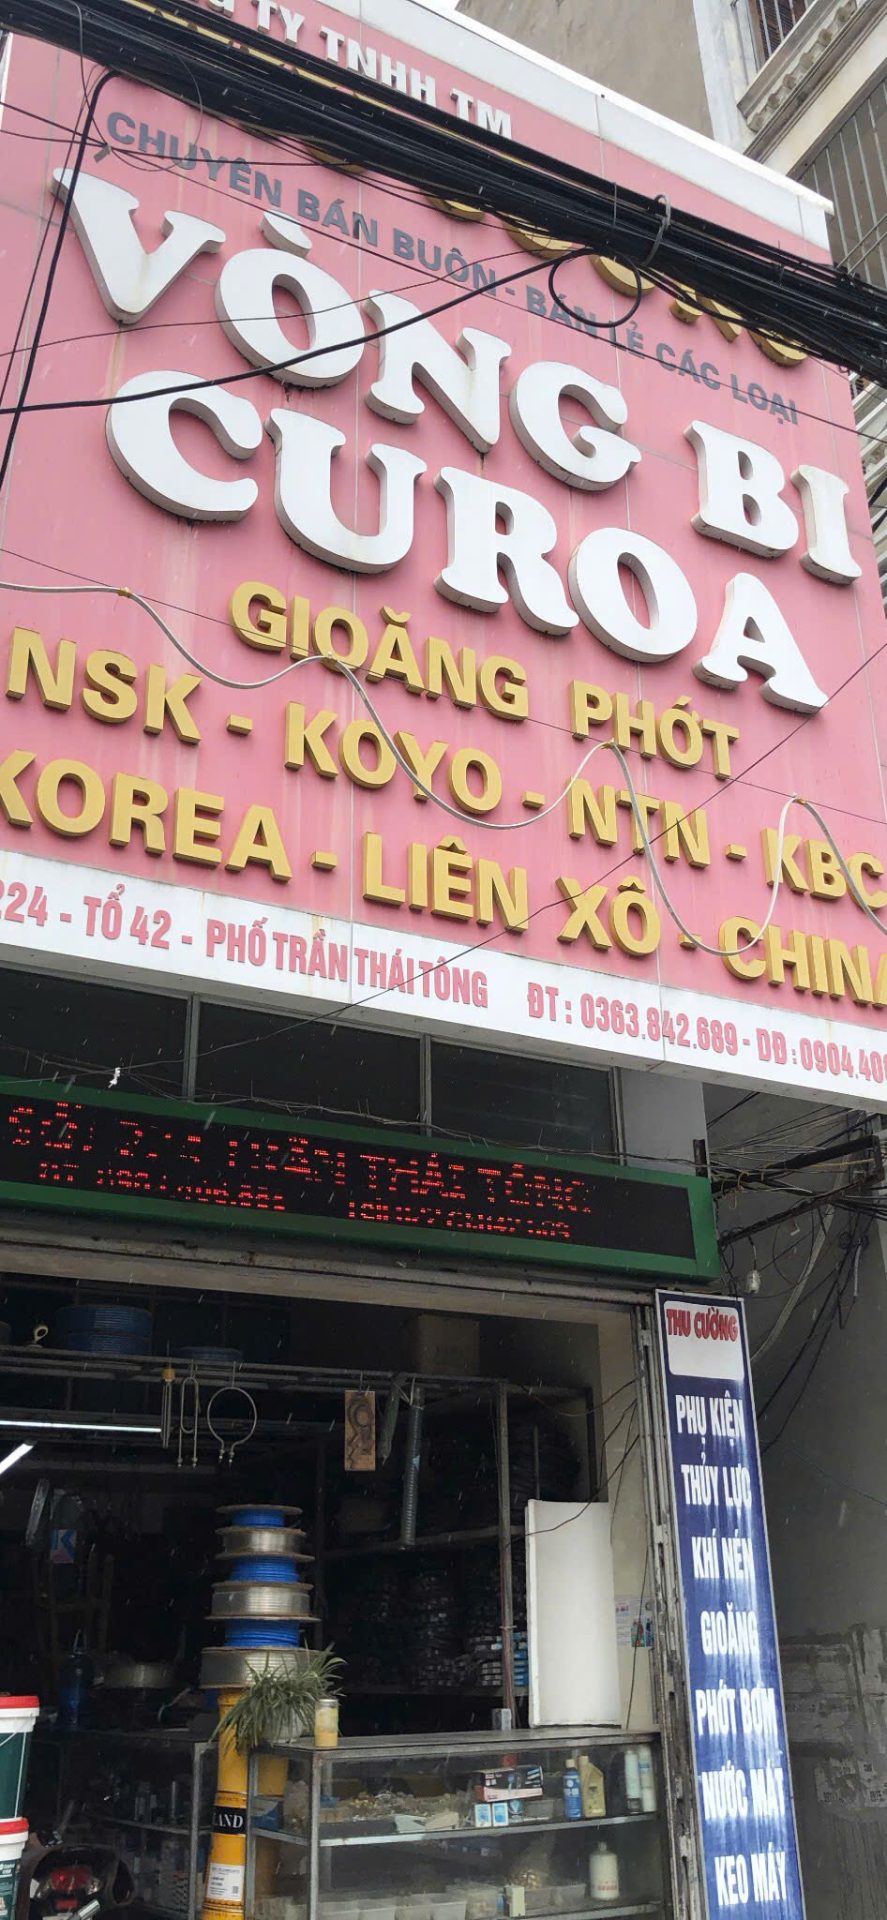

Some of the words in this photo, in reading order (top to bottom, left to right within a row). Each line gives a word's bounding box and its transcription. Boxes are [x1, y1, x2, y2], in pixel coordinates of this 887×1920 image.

[256, 0, 305, 46] TY
[320, 25, 437, 108] TNHH
[450, 88, 513, 140] TM
[97, 111, 283, 208] CHUYÊN
[297, 187, 379, 247] BÁN
[392, 227, 497, 296] BUÔN
[655, 342, 721, 391] CÁC
[731, 373, 800, 426] LOẠI
[53, 167, 642, 492] VÒNG
[683, 420, 862, 586] BI
[105, 370, 830, 713] CUROA
[230, 580, 529, 721] GIOĂNG
[569, 680, 741, 780] PHỚT
[6, 626, 202, 745] NSK
[284, 700, 503, 815] KOYO
[569, 777, 711, 868] NTN
[760, 827, 887, 911] KBC
[0, 749, 292, 884] KOREA
[363, 831, 530, 935] LIÊN
[554, 874, 662, 958] XÔ
[718, 915, 887, 1009] CHIN
[0, 879, 49, 927] 24
[83, 883, 126, 941] TỔ
[130, 905, 173, 950] 42
[206, 916, 270, 967] PHỐ
[272, 928, 349, 982] TRẦN
[354, 948, 415, 995] THÁI
[418, 955, 489, 1009] TÔNG
[580, 992, 738, 1057] 0363.842.689
[799, 1037, 887, 1085] 0904.40
[666, 1308, 692, 1338] THU
[694, 1306, 739, 1342] CƯỜNG
[675, 1394, 708, 1445] PHỤ
[709, 1389, 746, 1447] KIỆN
[681, 1451, 719, 1506] THỦY
[722, 1462, 753, 1521] LỰC
[691, 1528, 720, 1580] KHÍ
[721, 1528, 756, 1580] NÉN
[700, 1601, 760, 1656] GIOĂNG
[695, 1678, 737, 1737] PHỚT
[740, 1679, 779, 1738] BƠM
[701, 1759, 749, 1820] NƯỚC
[750, 1758, 786, 1818] MÁT
[714, 1854, 750, 1907] KEO
[751, 1841, 788, 1903] MÁY
